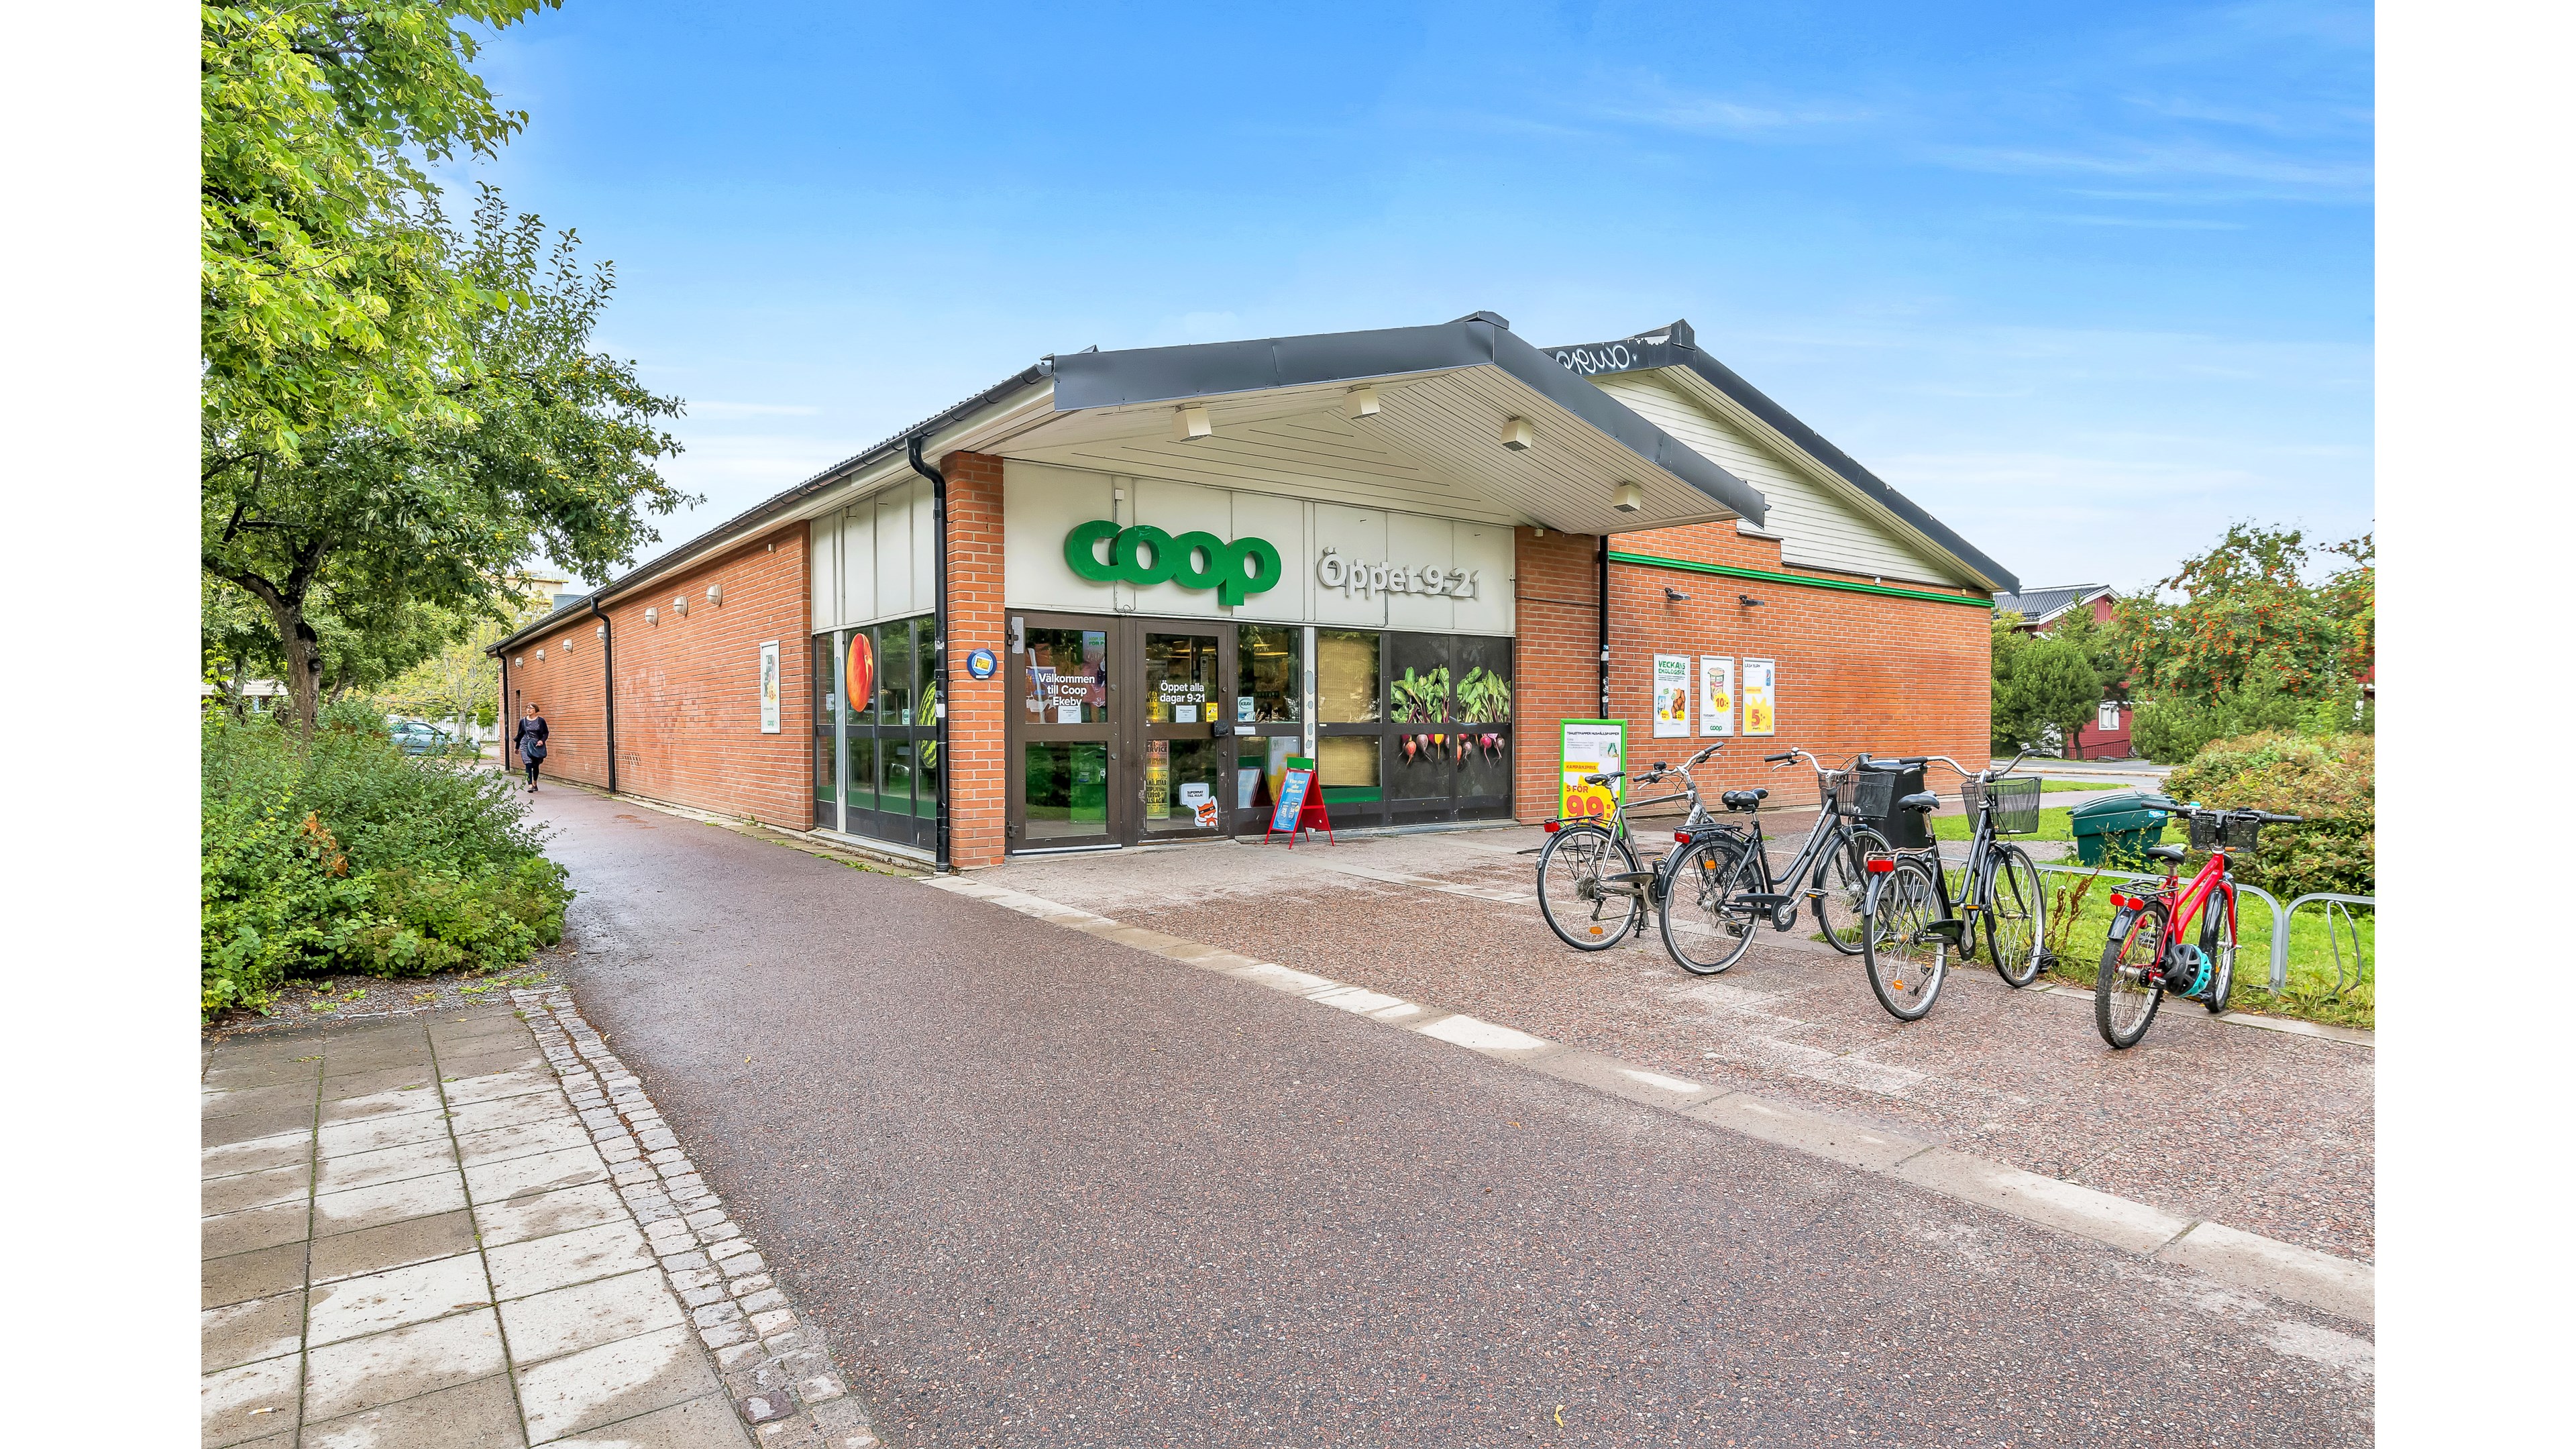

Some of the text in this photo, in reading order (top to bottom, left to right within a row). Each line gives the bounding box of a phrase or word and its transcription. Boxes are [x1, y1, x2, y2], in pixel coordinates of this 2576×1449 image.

[1064, 520, 1282, 606] coop
[1318, 546, 1481, 599] Öppet 9-21
[1658, 660, 1685, 669] VECKANS
[1038, 673, 1095, 684] Välkommen
[1046, 684, 1087, 696] till Coop
[1160, 680, 1205, 693] Öppet alla
[1053, 696, 1083, 706] Ekeby
[1160, 694, 1185, 704] dagar
[1187, 694, 1205, 702] 9-21
[1572, 784, 1589, 793] FÖR
